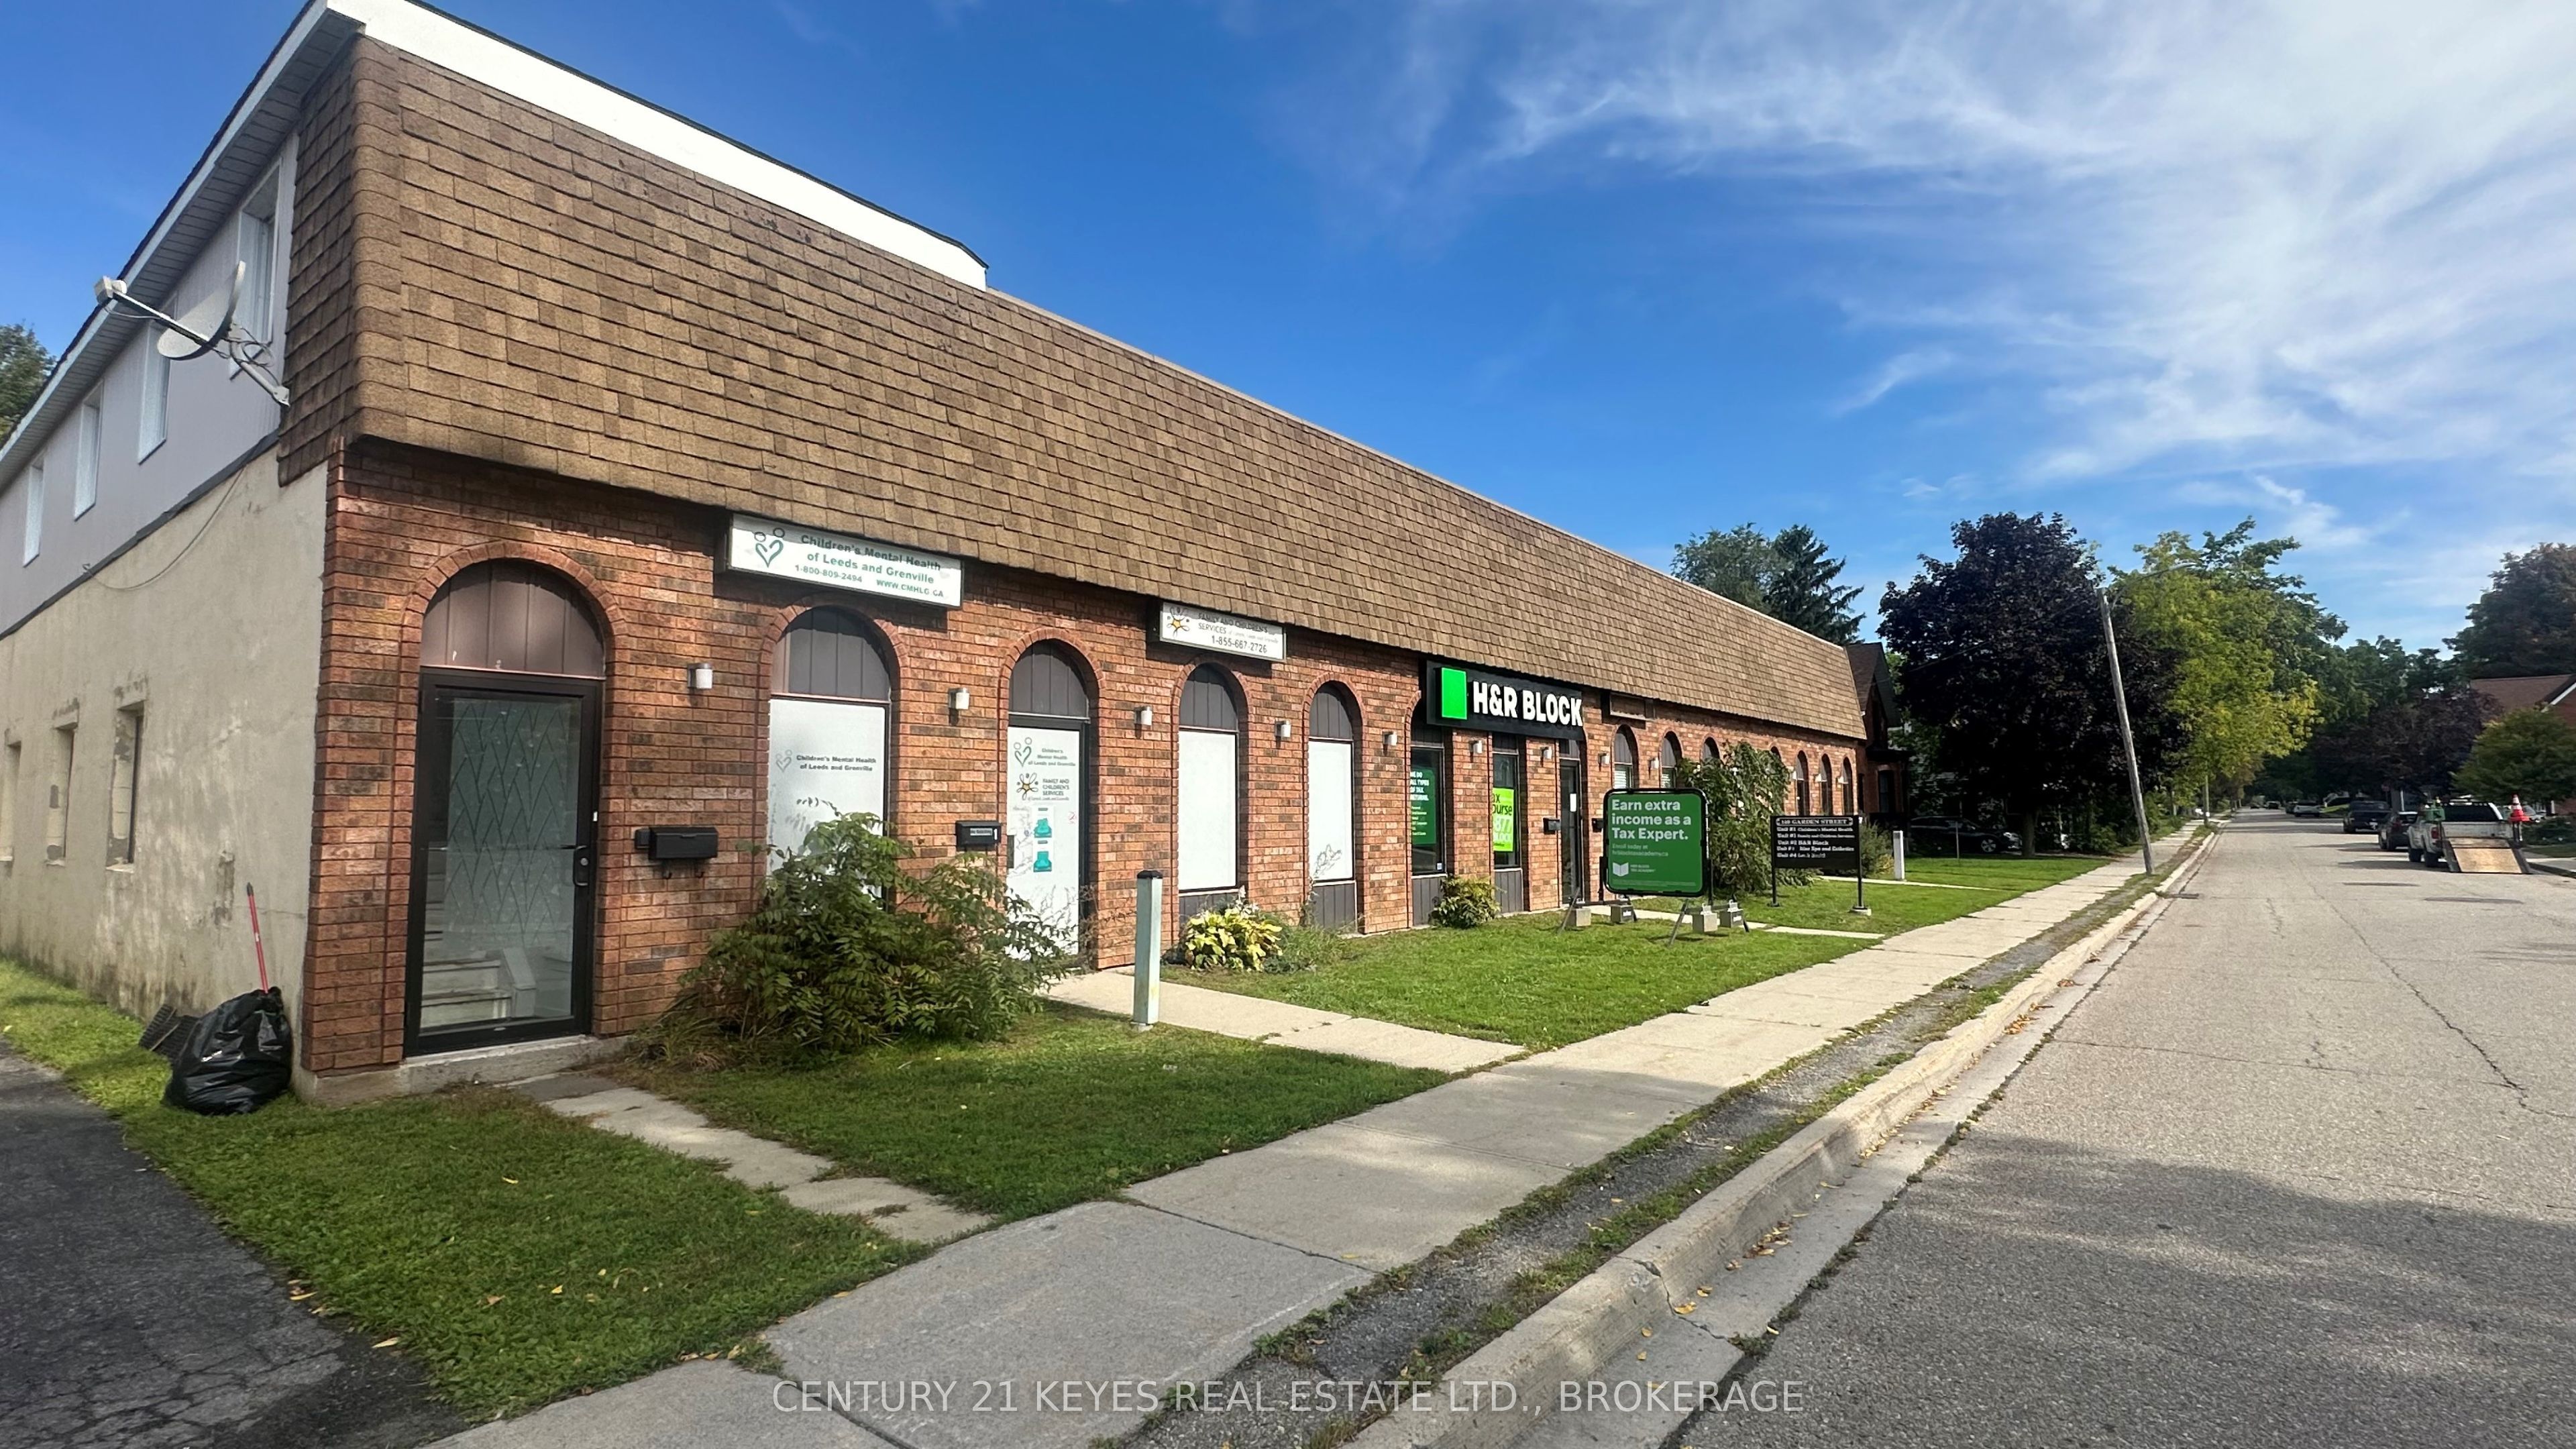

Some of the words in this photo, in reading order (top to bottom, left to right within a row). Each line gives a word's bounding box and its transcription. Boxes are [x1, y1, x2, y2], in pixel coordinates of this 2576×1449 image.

[801, 535, 861, 555] Children's
[865, 547, 902, 563] Mental
[906, 556, 941, 571] Health
[795, 564, 863, 582] 1-800-809-2494
[807, 553, 819, 561] of
[822, 554, 858, 569] Leeds
[861, 564, 883, 574] and
[886, 567, 934, 584] Grenville
[1198, 623, 1226, 634] SERVICES
[1212, 635, 1268, 653] 1-855-667-2726
[1473, 681, 1517, 718] H&R
[1522, 690, 1583, 727] BLOCK
[1492, 793, 1501, 804] ax
[1611, 799, 1642, 811] Earn
[1645, 800, 1680, 811] extra
[1492, 804, 1513, 816] ourse
[1611, 813, 1662, 825] income
[1664, 816, 1680, 825] as
[1682, 816, 1691, 825] a
[994, 828, 998, 840] 1
[1611, 827, 1635, 839] Tax
[1638, 828, 1688, 842] Expert.
